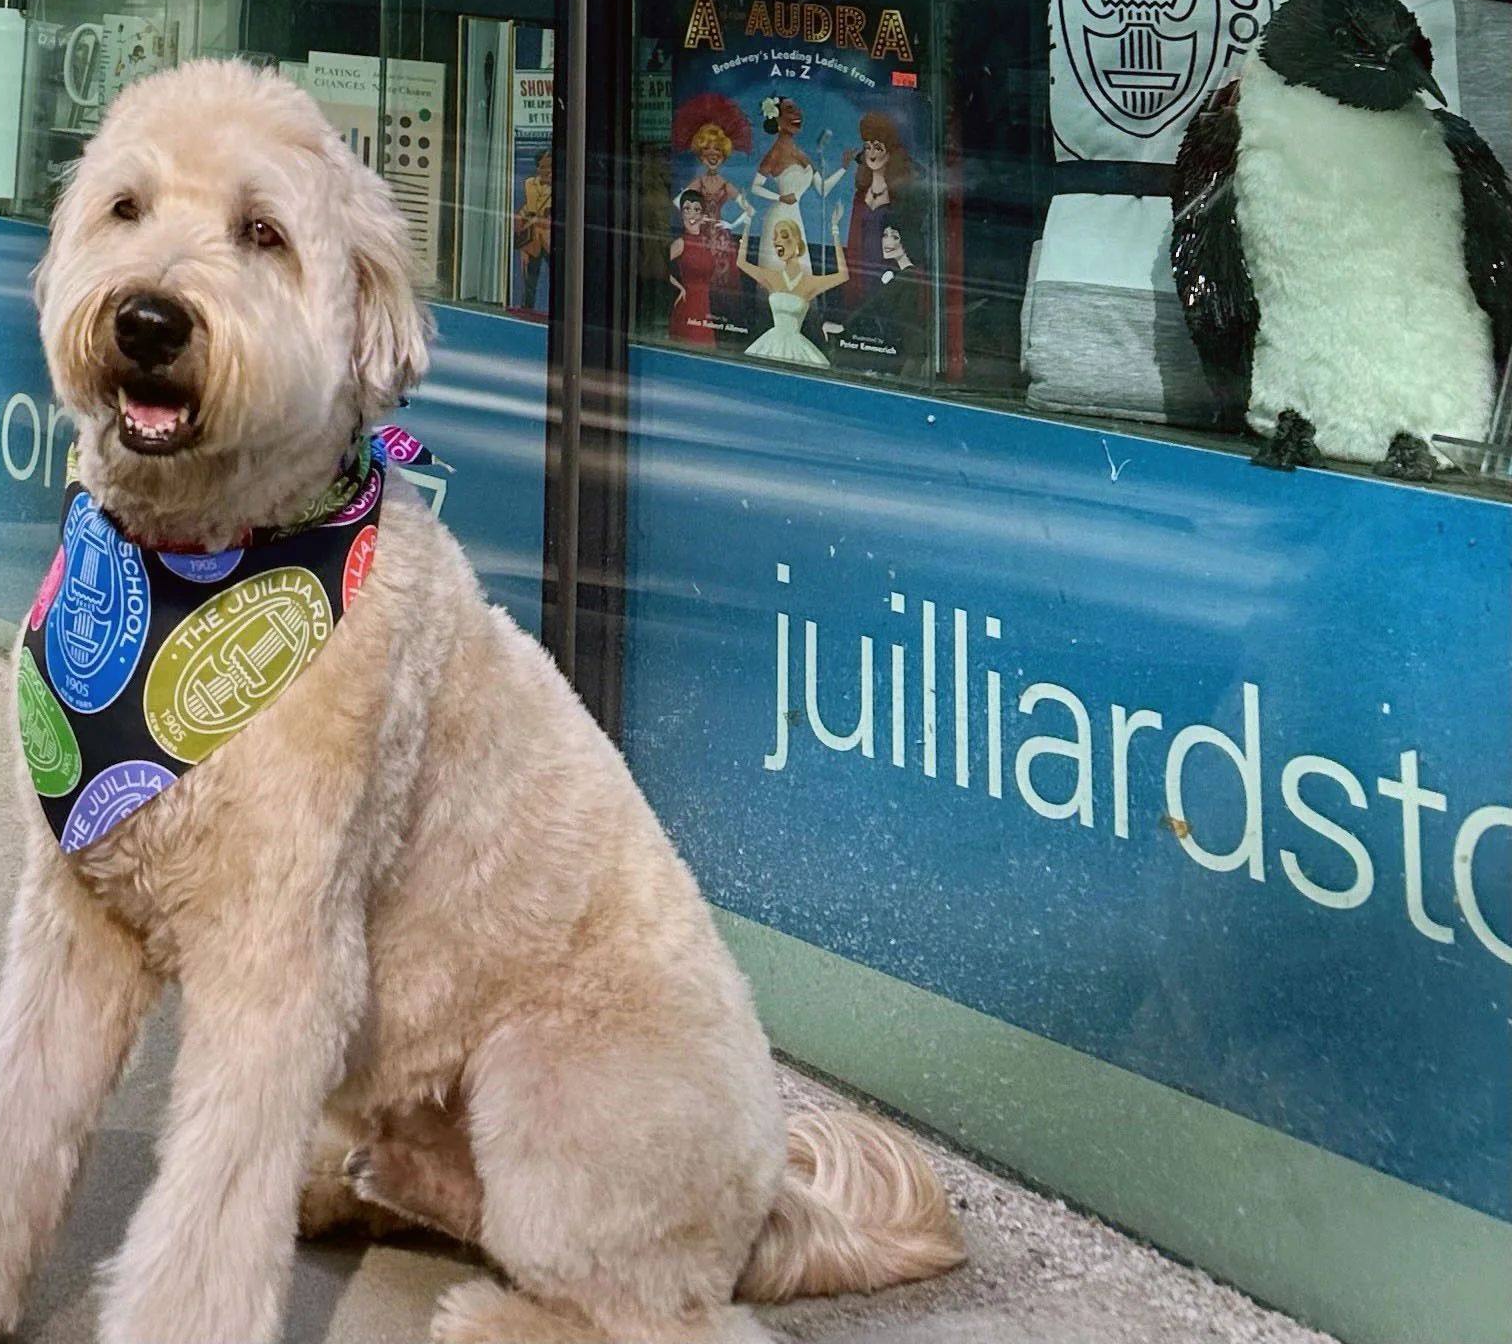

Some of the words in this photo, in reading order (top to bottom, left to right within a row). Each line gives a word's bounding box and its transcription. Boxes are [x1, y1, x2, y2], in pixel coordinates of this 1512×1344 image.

[745, 0, 914, 62] AUDRA
[314, 65, 361, 79] PLAYING
[314, 78, 366, 91] CHANGES
[711, 50, 769, 75] Broadway's
[771, 49, 812, 65] Leading
[815, 53, 849, 74] Ladies
[850, 66, 876, 89] from
[770, 63, 782, 77] A
[786, 69, 796, 78] to
[799, 65, 811, 80] Z
[189, 559, 218, 572] 1905
[117, 540, 144, 648] SCHOOL
[176, 607, 225, 650] THE
[227, 574, 328, 642] JUILLIARD
[64, 675, 91, 698] 1905
[159, 708, 187, 743] 1905
[88, 769, 163, 817] JUILLIA
